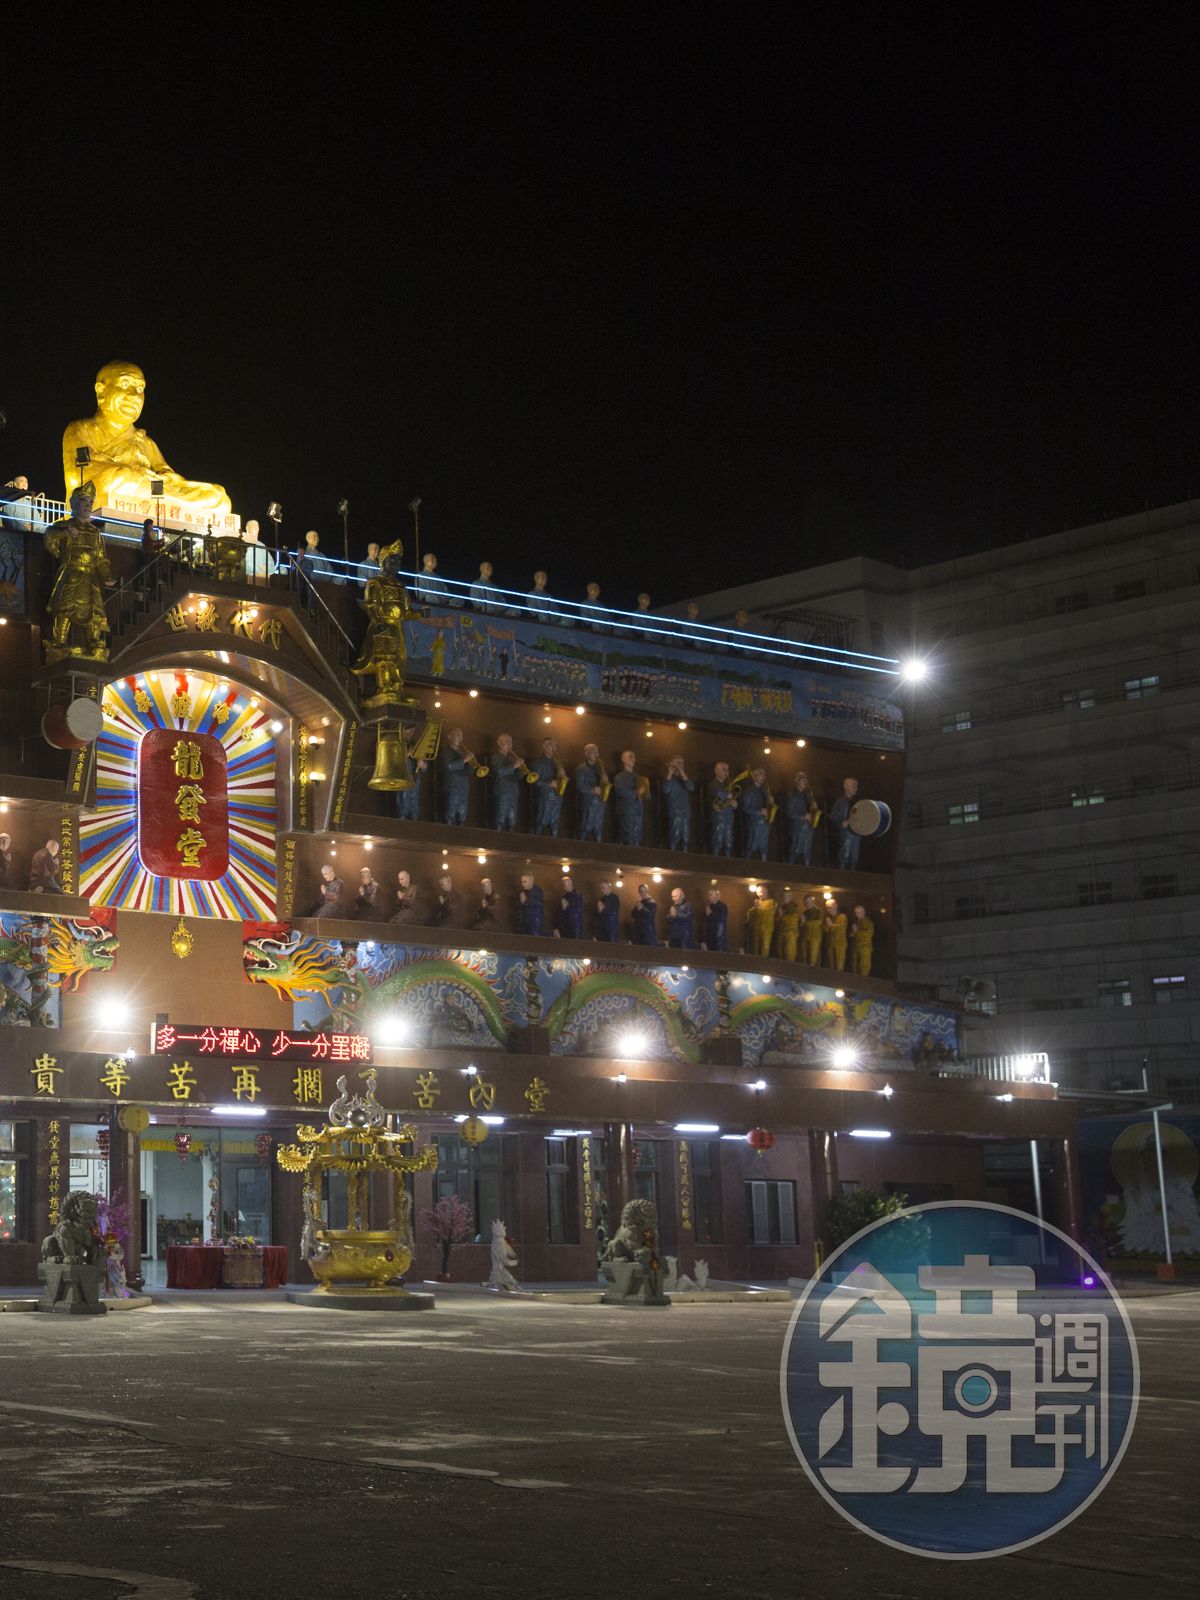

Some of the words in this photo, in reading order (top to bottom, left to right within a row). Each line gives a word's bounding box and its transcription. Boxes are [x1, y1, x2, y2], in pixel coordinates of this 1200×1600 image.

[170, 740, 207, 868] 龍發堂
[156, 1023, 261, 1054] 多一分禪心
